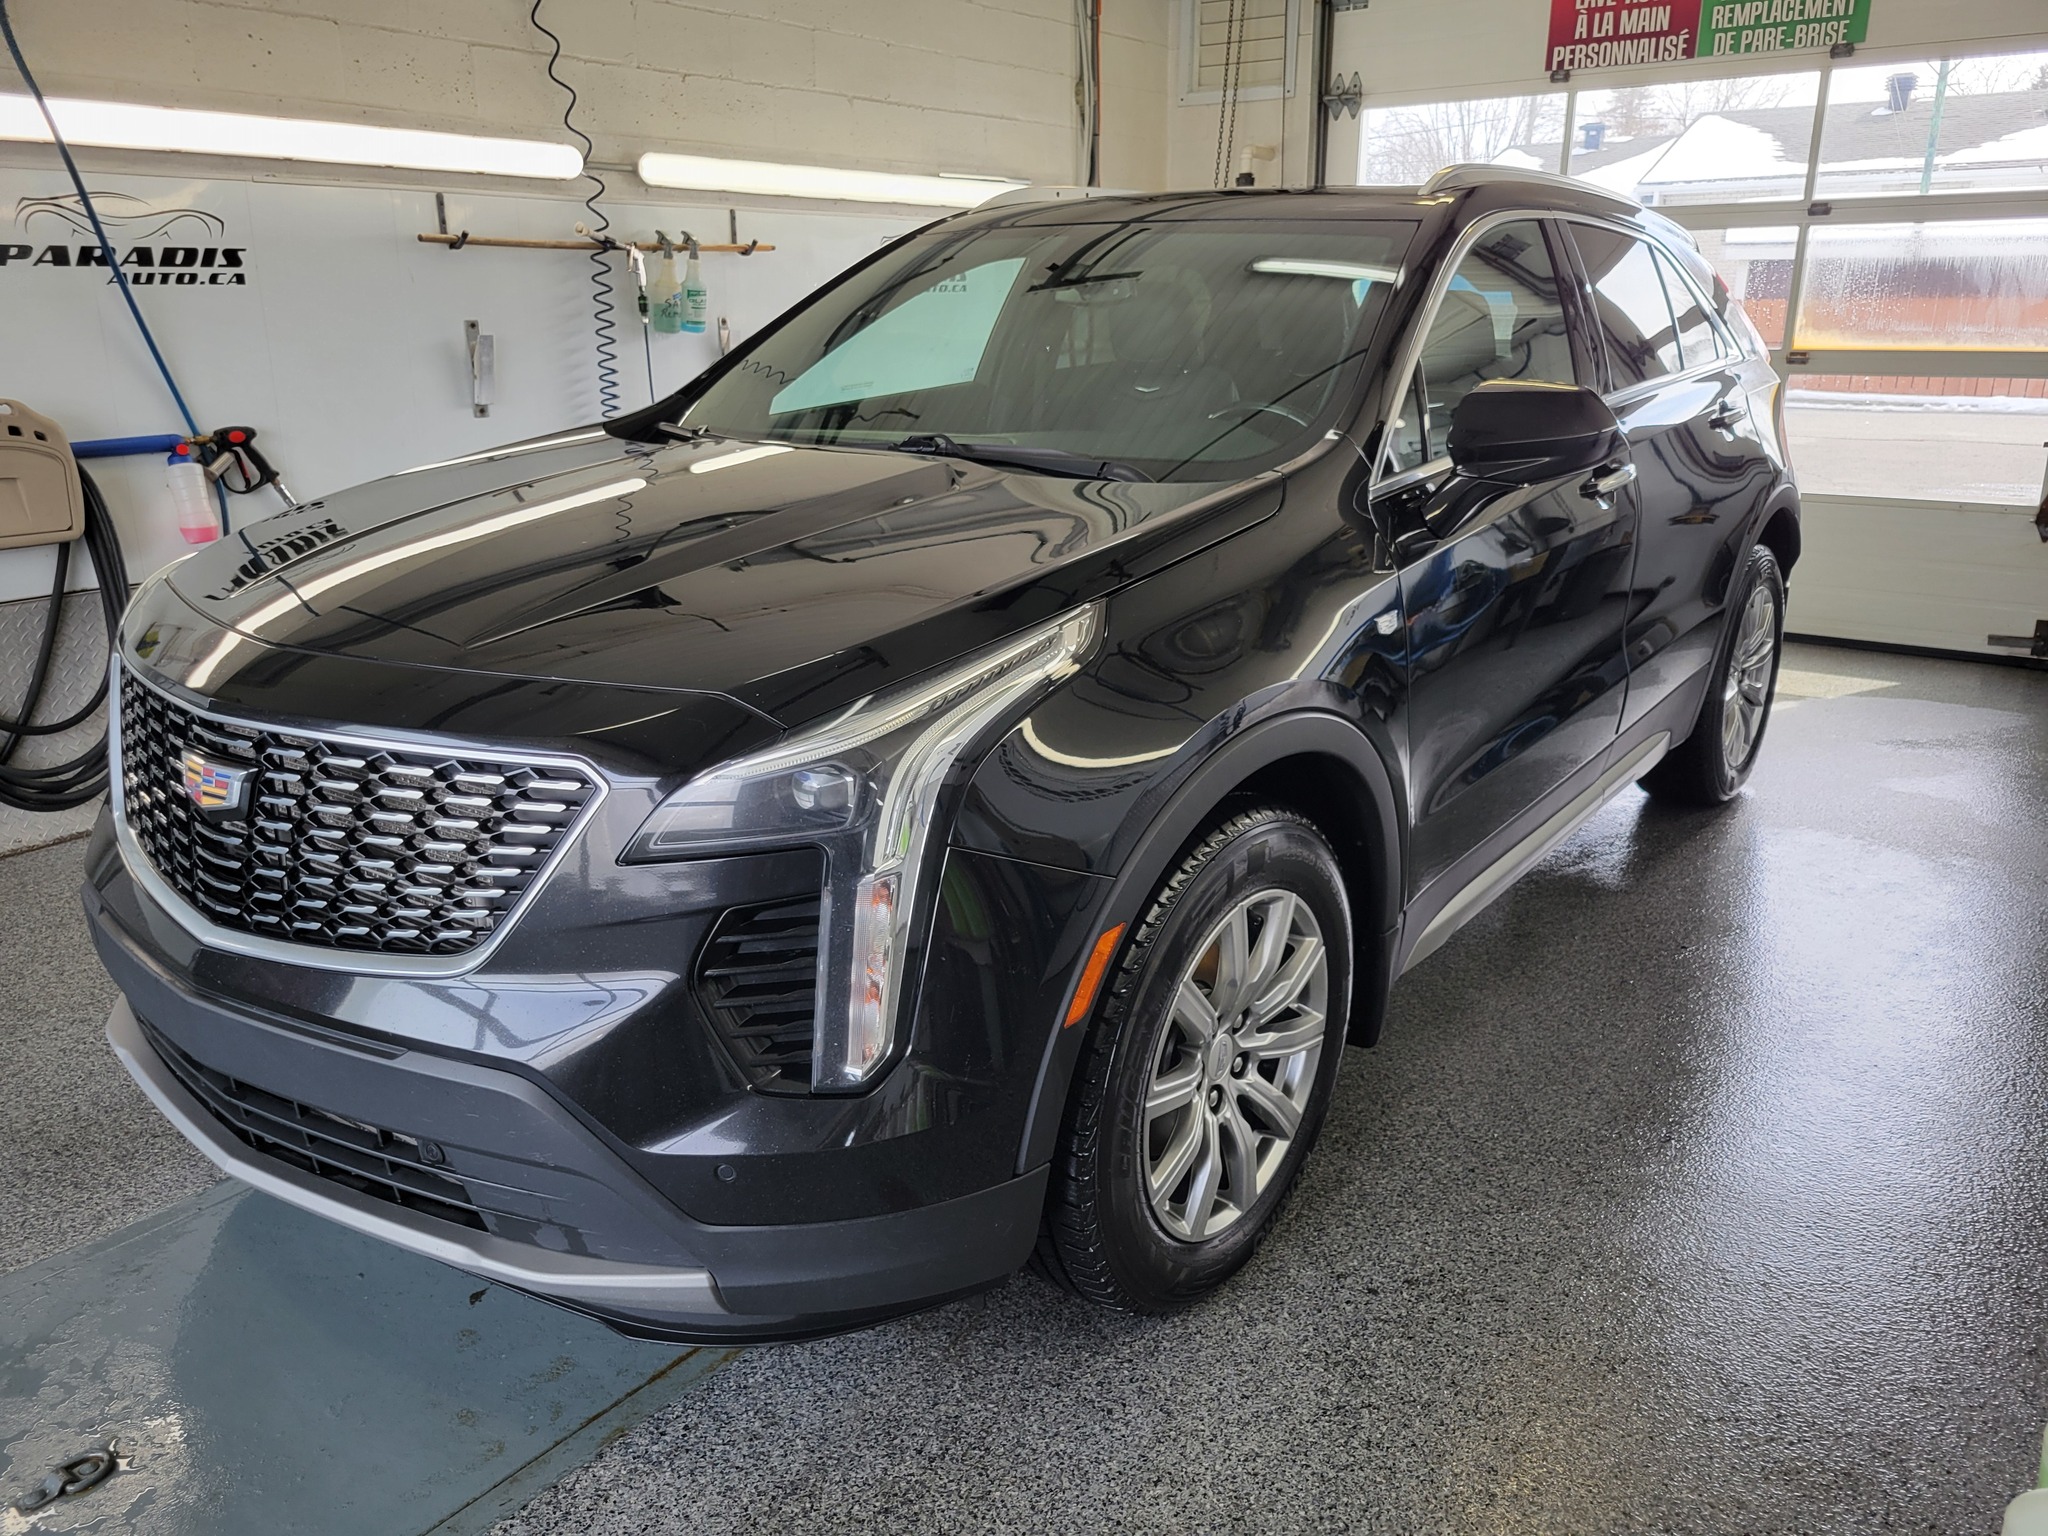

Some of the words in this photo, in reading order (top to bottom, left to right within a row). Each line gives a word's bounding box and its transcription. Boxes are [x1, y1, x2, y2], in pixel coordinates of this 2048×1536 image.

[1574, 9, 1588, 40] À
[1592, 11, 1614, 38] LA
[1618, 5, 1671, 35] MAIN
[1711, 0, 1855, 29] REMPLACEMENT
[1551, 28, 1690, 71] PERSONNALISÉ
[1713, 32, 1737, 56] DE
[1740, 20, 1850, 53] PARE-BRISE
[0, 244, 247, 268] PARADIS
[106, 272, 246, 286] AUTO.CA
